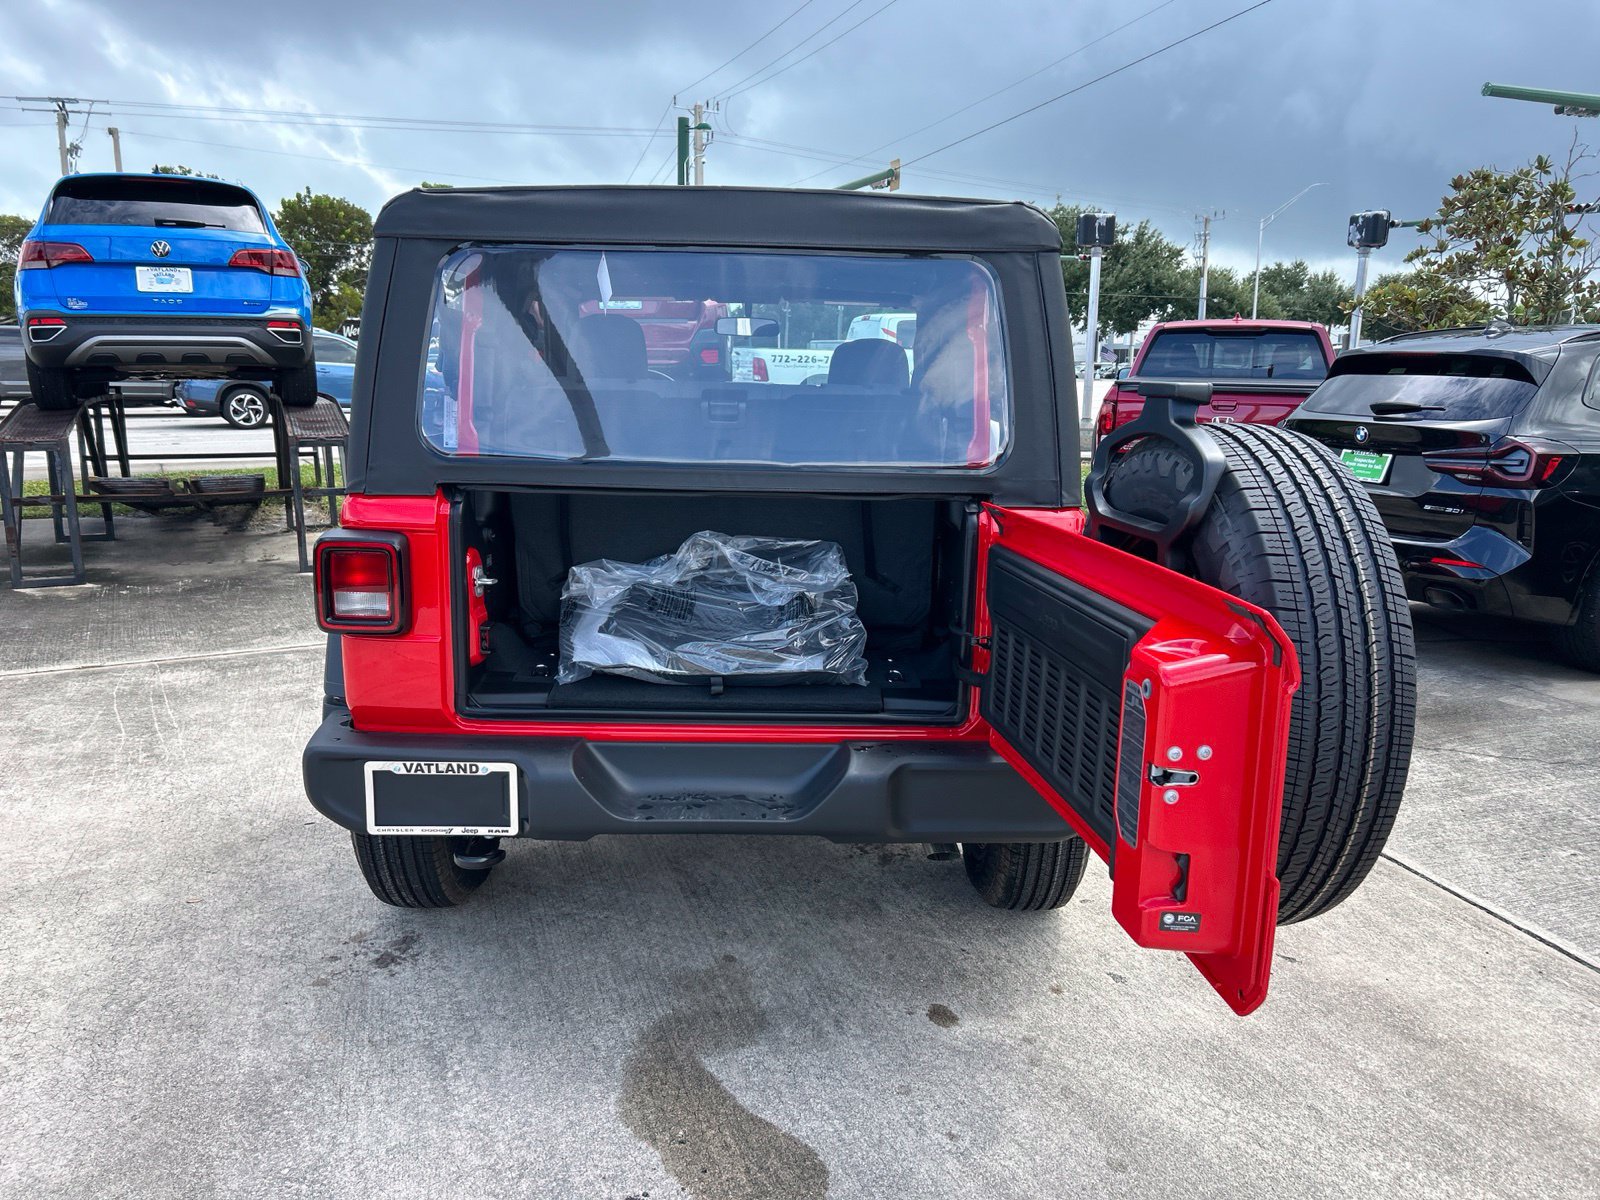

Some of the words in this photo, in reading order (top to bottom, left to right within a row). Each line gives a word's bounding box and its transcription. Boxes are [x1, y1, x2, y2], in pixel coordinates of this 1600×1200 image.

[342, 324, 360, 338] We
[771, 354, 830, 364] 772-226-7
[402, 762, 479, 774] VATLAND
